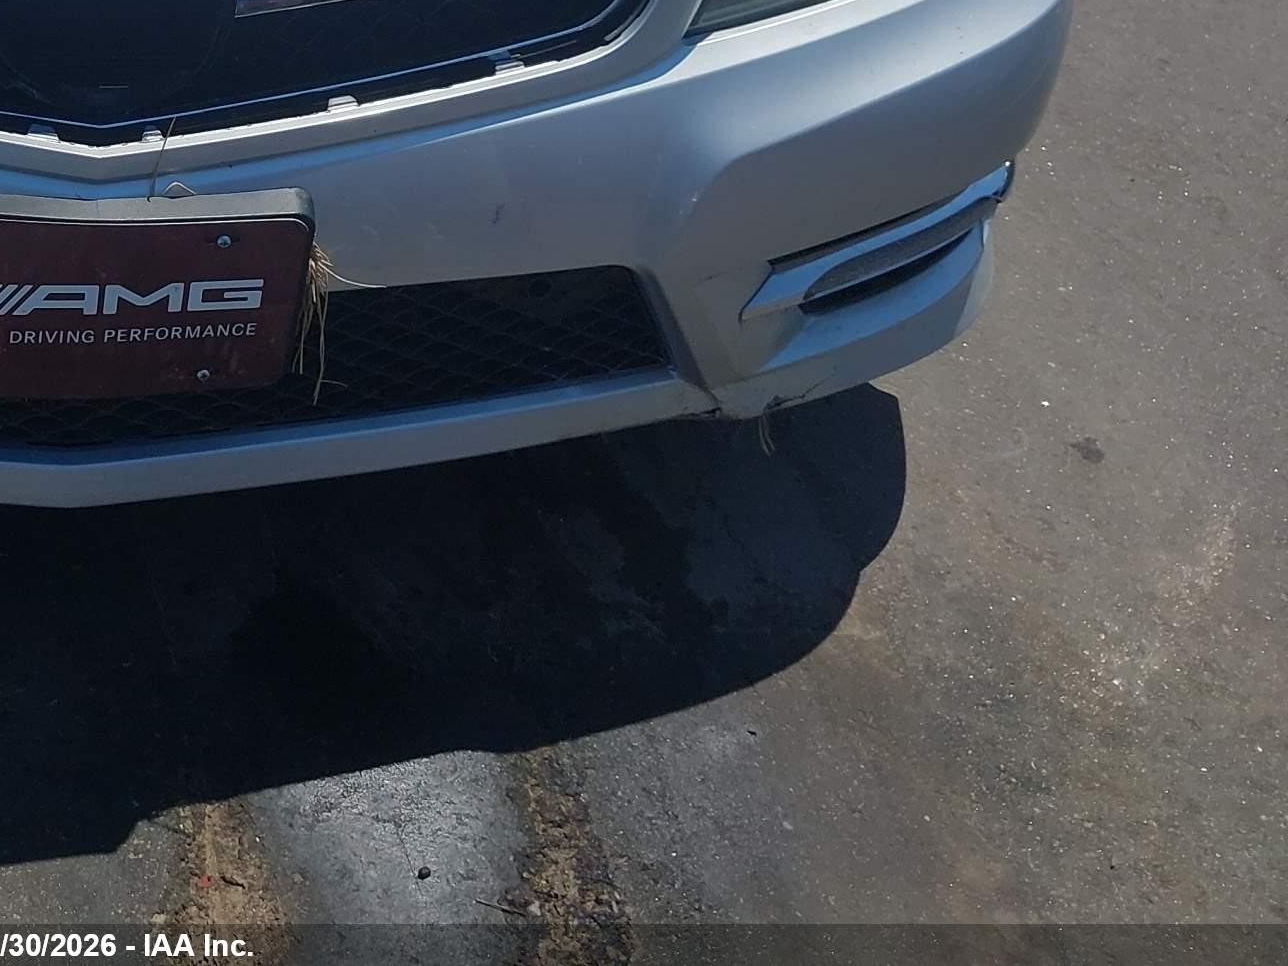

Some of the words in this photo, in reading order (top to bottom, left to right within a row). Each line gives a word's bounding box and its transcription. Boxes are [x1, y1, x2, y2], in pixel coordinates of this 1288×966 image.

[13, 279, 264, 315] AMG
[9, 330, 95, 344] DRIVING
[103, 322, 257, 343] PERFORMANCE
